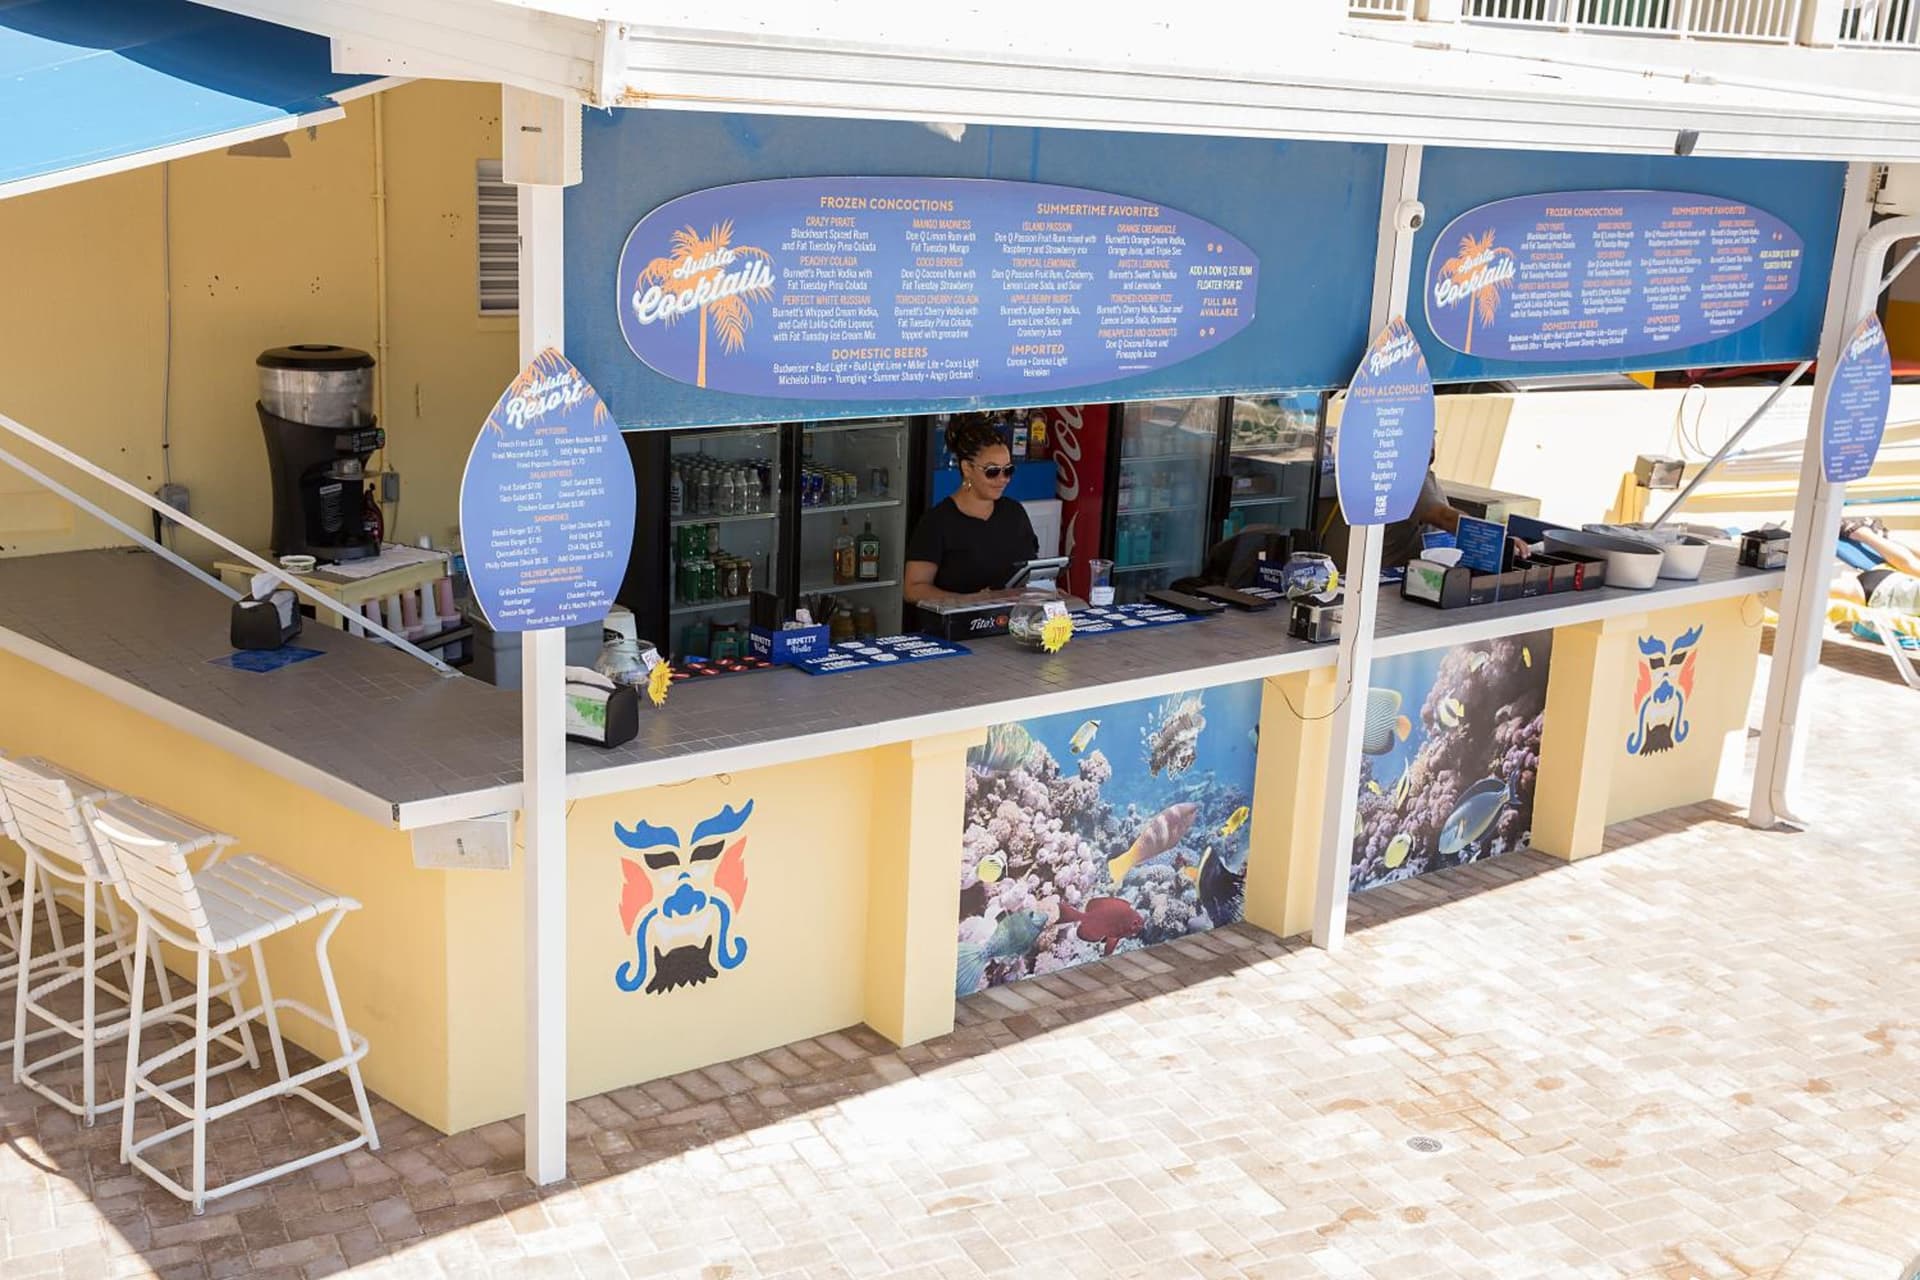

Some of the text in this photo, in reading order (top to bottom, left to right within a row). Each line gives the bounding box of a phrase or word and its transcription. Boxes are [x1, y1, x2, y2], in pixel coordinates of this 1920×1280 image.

[821, 196, 954, 211] FROZEN CONCOCTIONS
[1037, 203, 1160, 218] SUMMERTIME FAVORITES
[632, 247, 776, 326] Avista Cocktails
[1434, 257, 1517, 308] Cocktails
[1199, 308, 1239, 318] AVAILABLE
[832, 347, 929, 361] DOMESTIC BEERS
[1011, 343, 1065, 355] IMPORTED
[1354, 383, 1429, 398] NON ALCOHOLIC
[506, 379, 584, 430] Resort
[970, 615, 995, 631] Tito's
